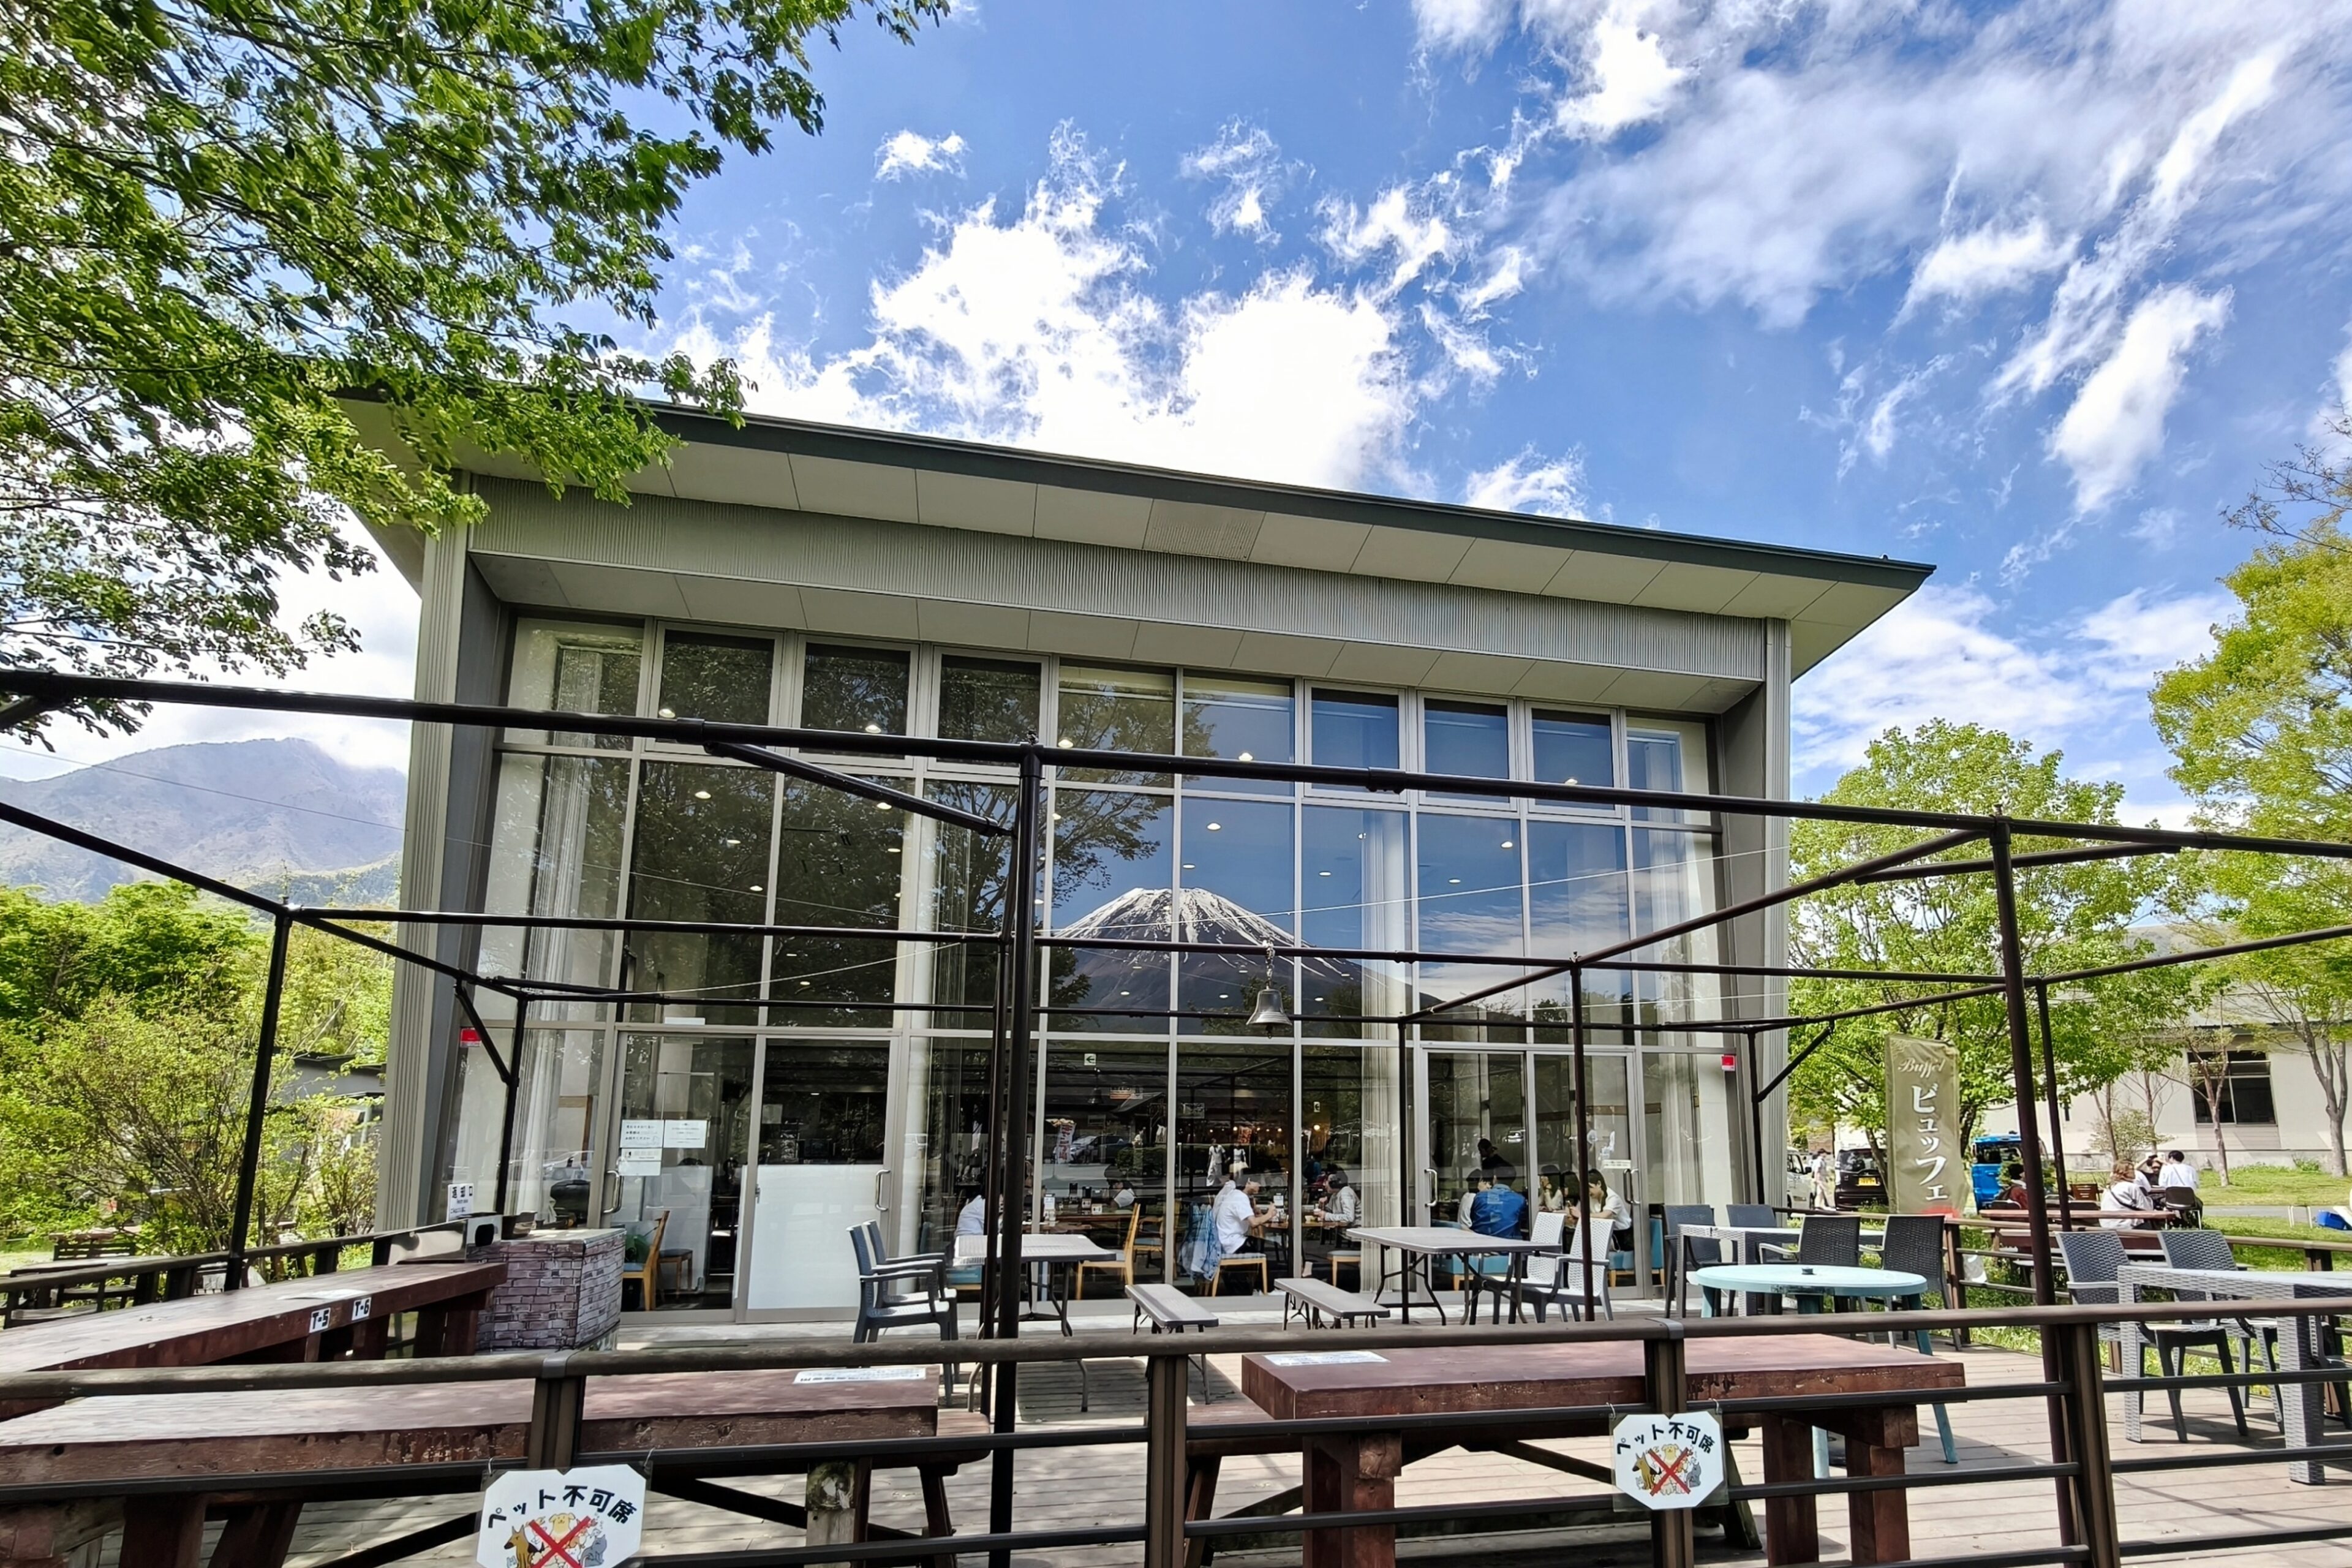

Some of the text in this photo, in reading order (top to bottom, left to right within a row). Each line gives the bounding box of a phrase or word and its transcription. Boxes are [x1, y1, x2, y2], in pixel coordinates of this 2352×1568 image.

[1912, 1083, 1948, 1200] ビュッフェ
[1617, 1422, 1715, 1455] ペット不可席
[488, 1485, 637, 1528] ペット不可席
